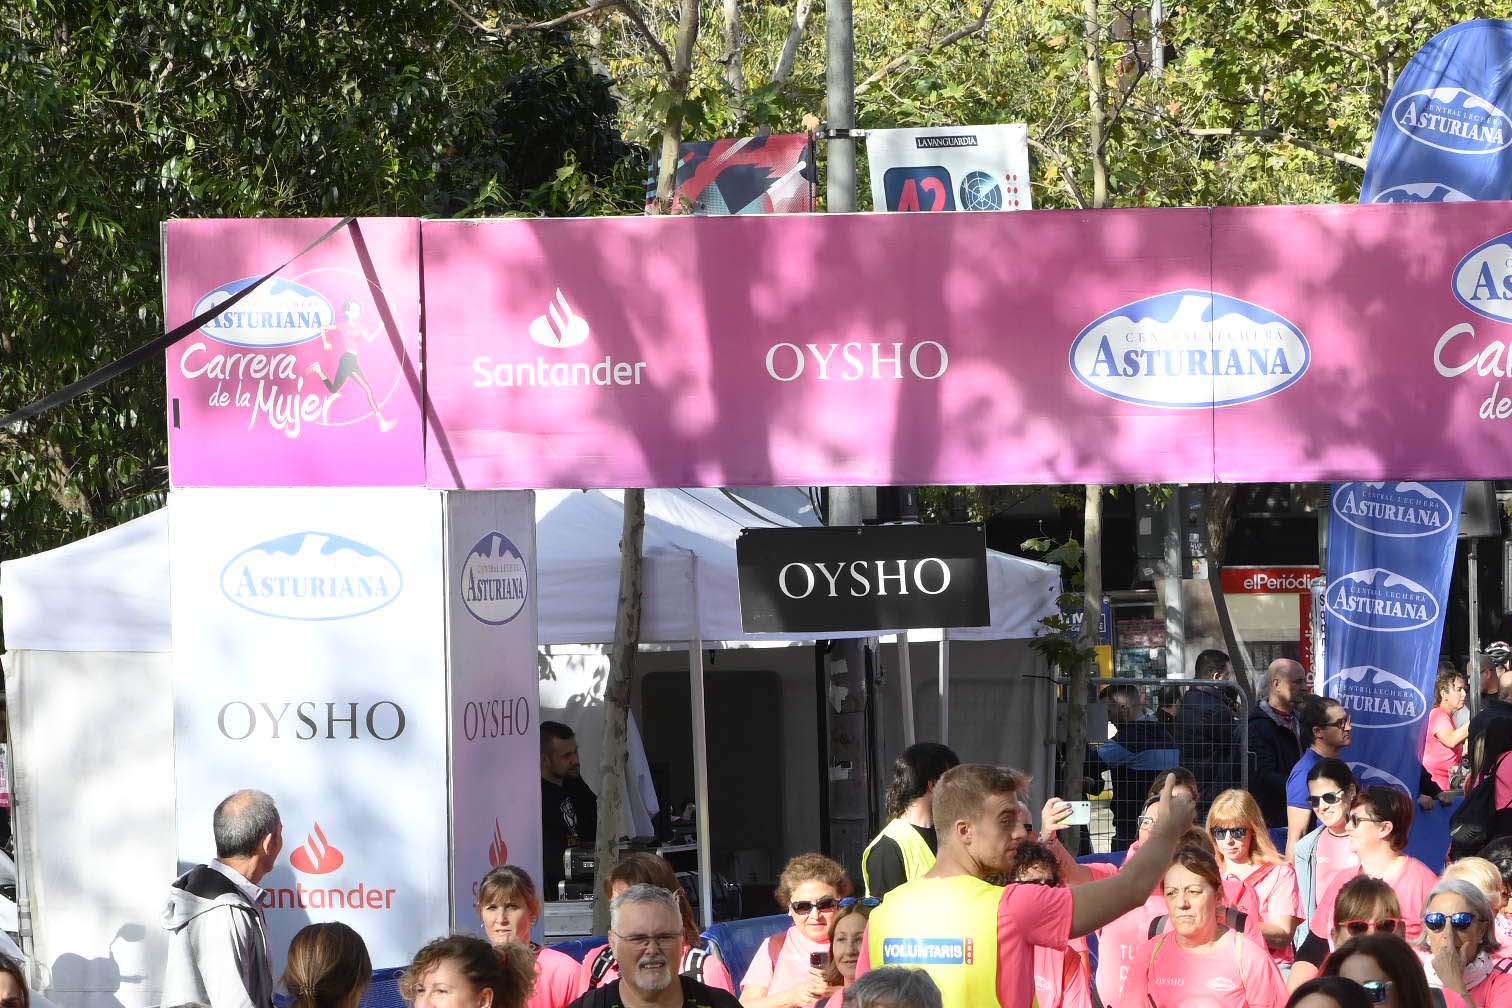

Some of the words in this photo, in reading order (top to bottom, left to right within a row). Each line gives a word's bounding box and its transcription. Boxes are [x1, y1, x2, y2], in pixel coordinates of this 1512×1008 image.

[1400, 102, 1504, 145] ASTURIANA
[204, 301, 322, 329] ASTURIANA
[180, 342, 297, 379] Carrera
[473, 356, 646, 389] Santander
[765, 340, 948, 383] OYSHO
[1089, 334, 1292, 377] ASTURIANA
[208, 382, 230, 407] de
[235, 380, 250, 407] la
[248, 376, 343, 437] Mujer
[1341, 491, 1441, 528] ASTURIANA
[1396, 496, 1440, 509] LECHERA
[235, 565, 389, 599] ASTURIANA
[466, 566, 525, 602] ASTURIANA
[778, 557, 951, 599] OYSHO
[1243, 573, 1313, 590] elPeriódi
[1333, 585, 1428, 621] ASTURIANA
[217, 701, 406, 741] OYSHO
[463, 696, 530, 741] OYSHO
[261, 884, 395, 910] antander
[884, 944, 963, 959] VOLUNTARIS
